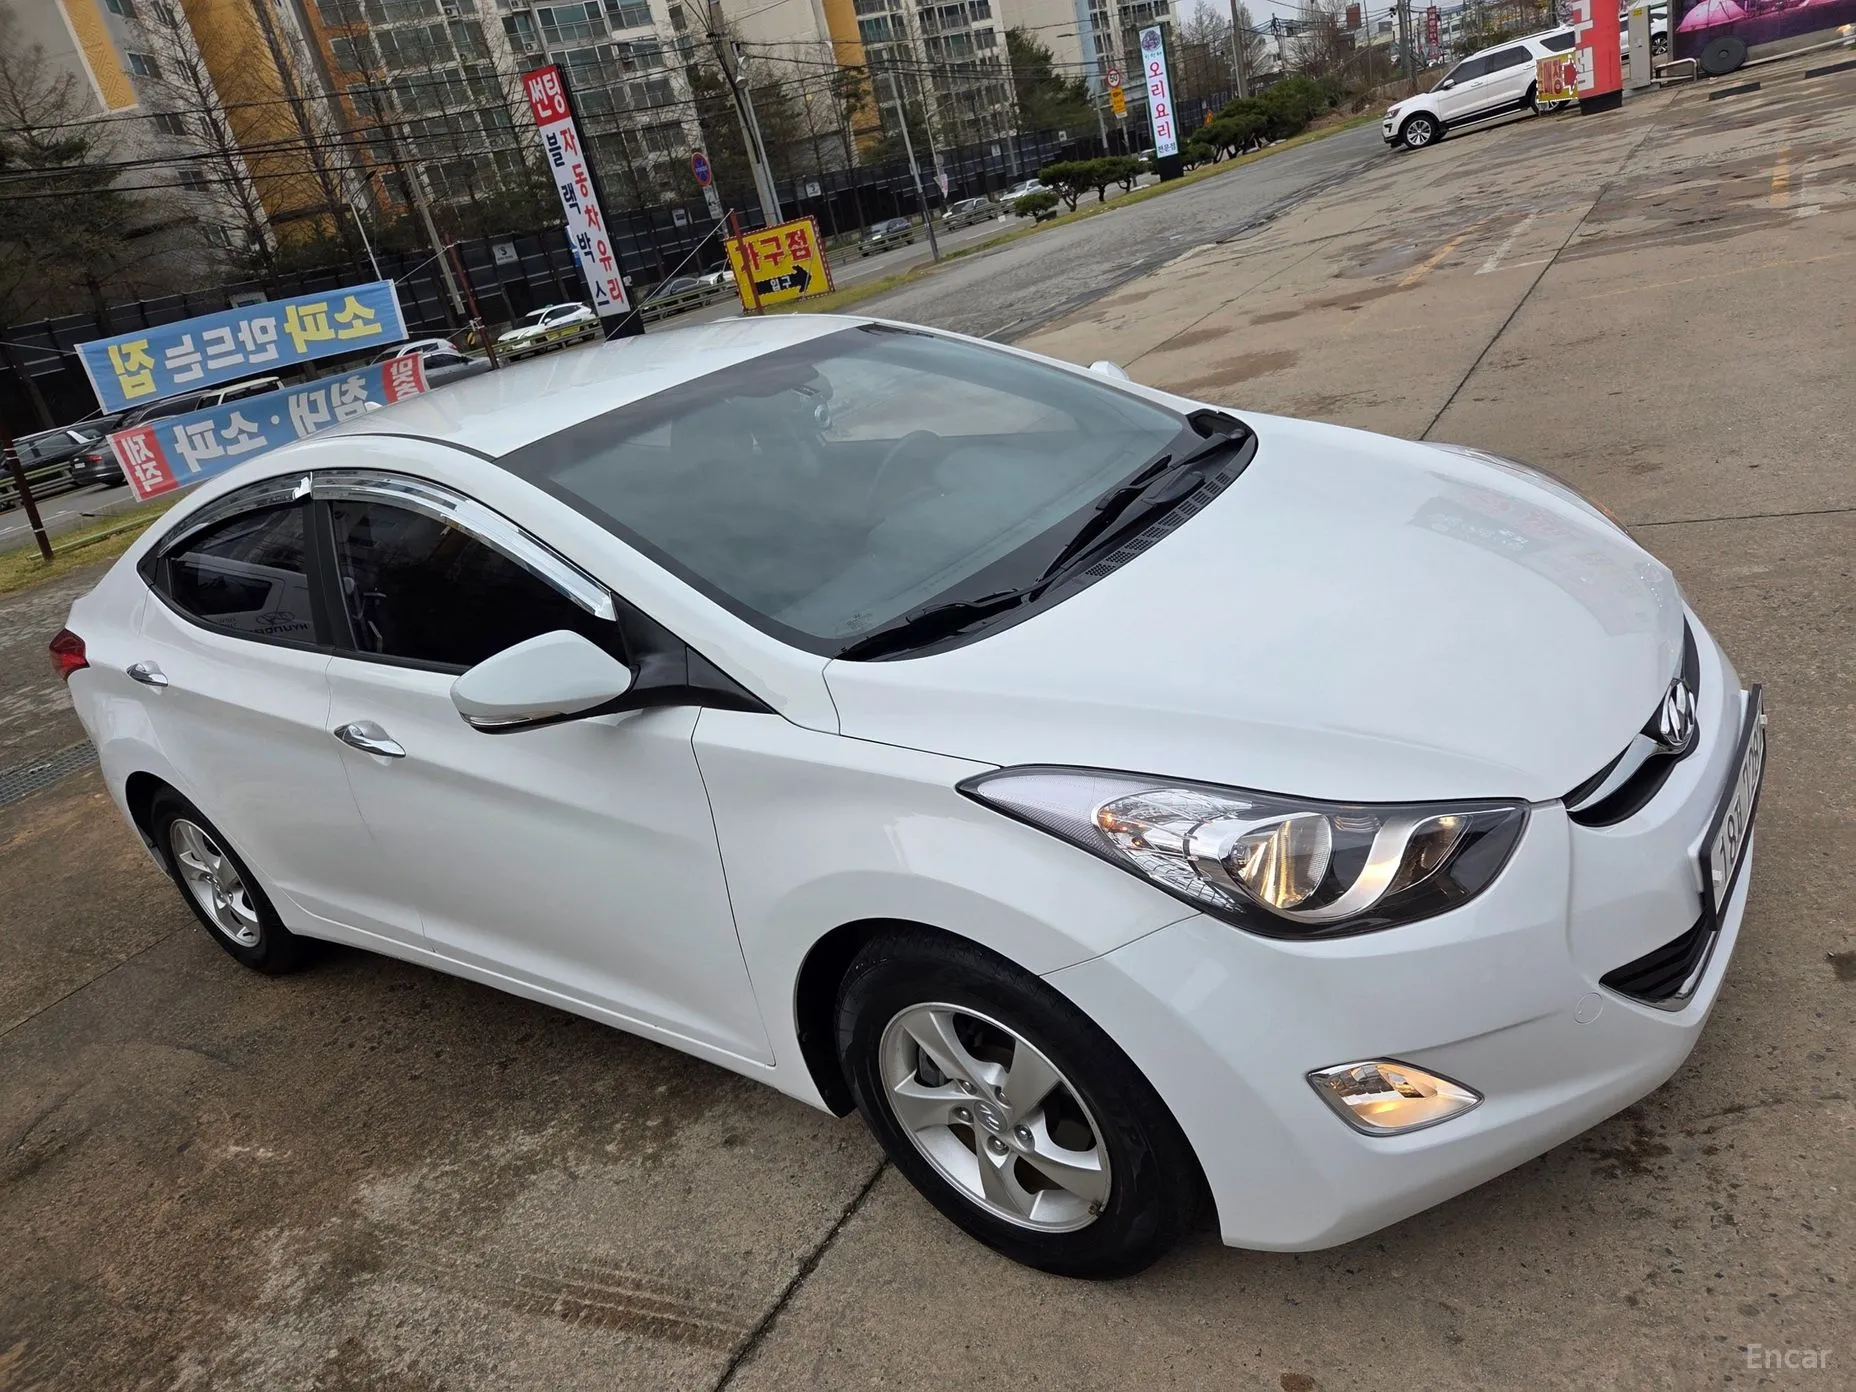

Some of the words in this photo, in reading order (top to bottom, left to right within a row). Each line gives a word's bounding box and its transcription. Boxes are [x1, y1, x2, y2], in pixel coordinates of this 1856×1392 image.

[528, 71, 565, 117] 썬팅
[1149, 61, 1170, 139] 오리요리
[1157, 142, 1177, 153] 전문점
[546, 131, 610, 307] 블랙박스
[770, 275, 791, 291] 입구
